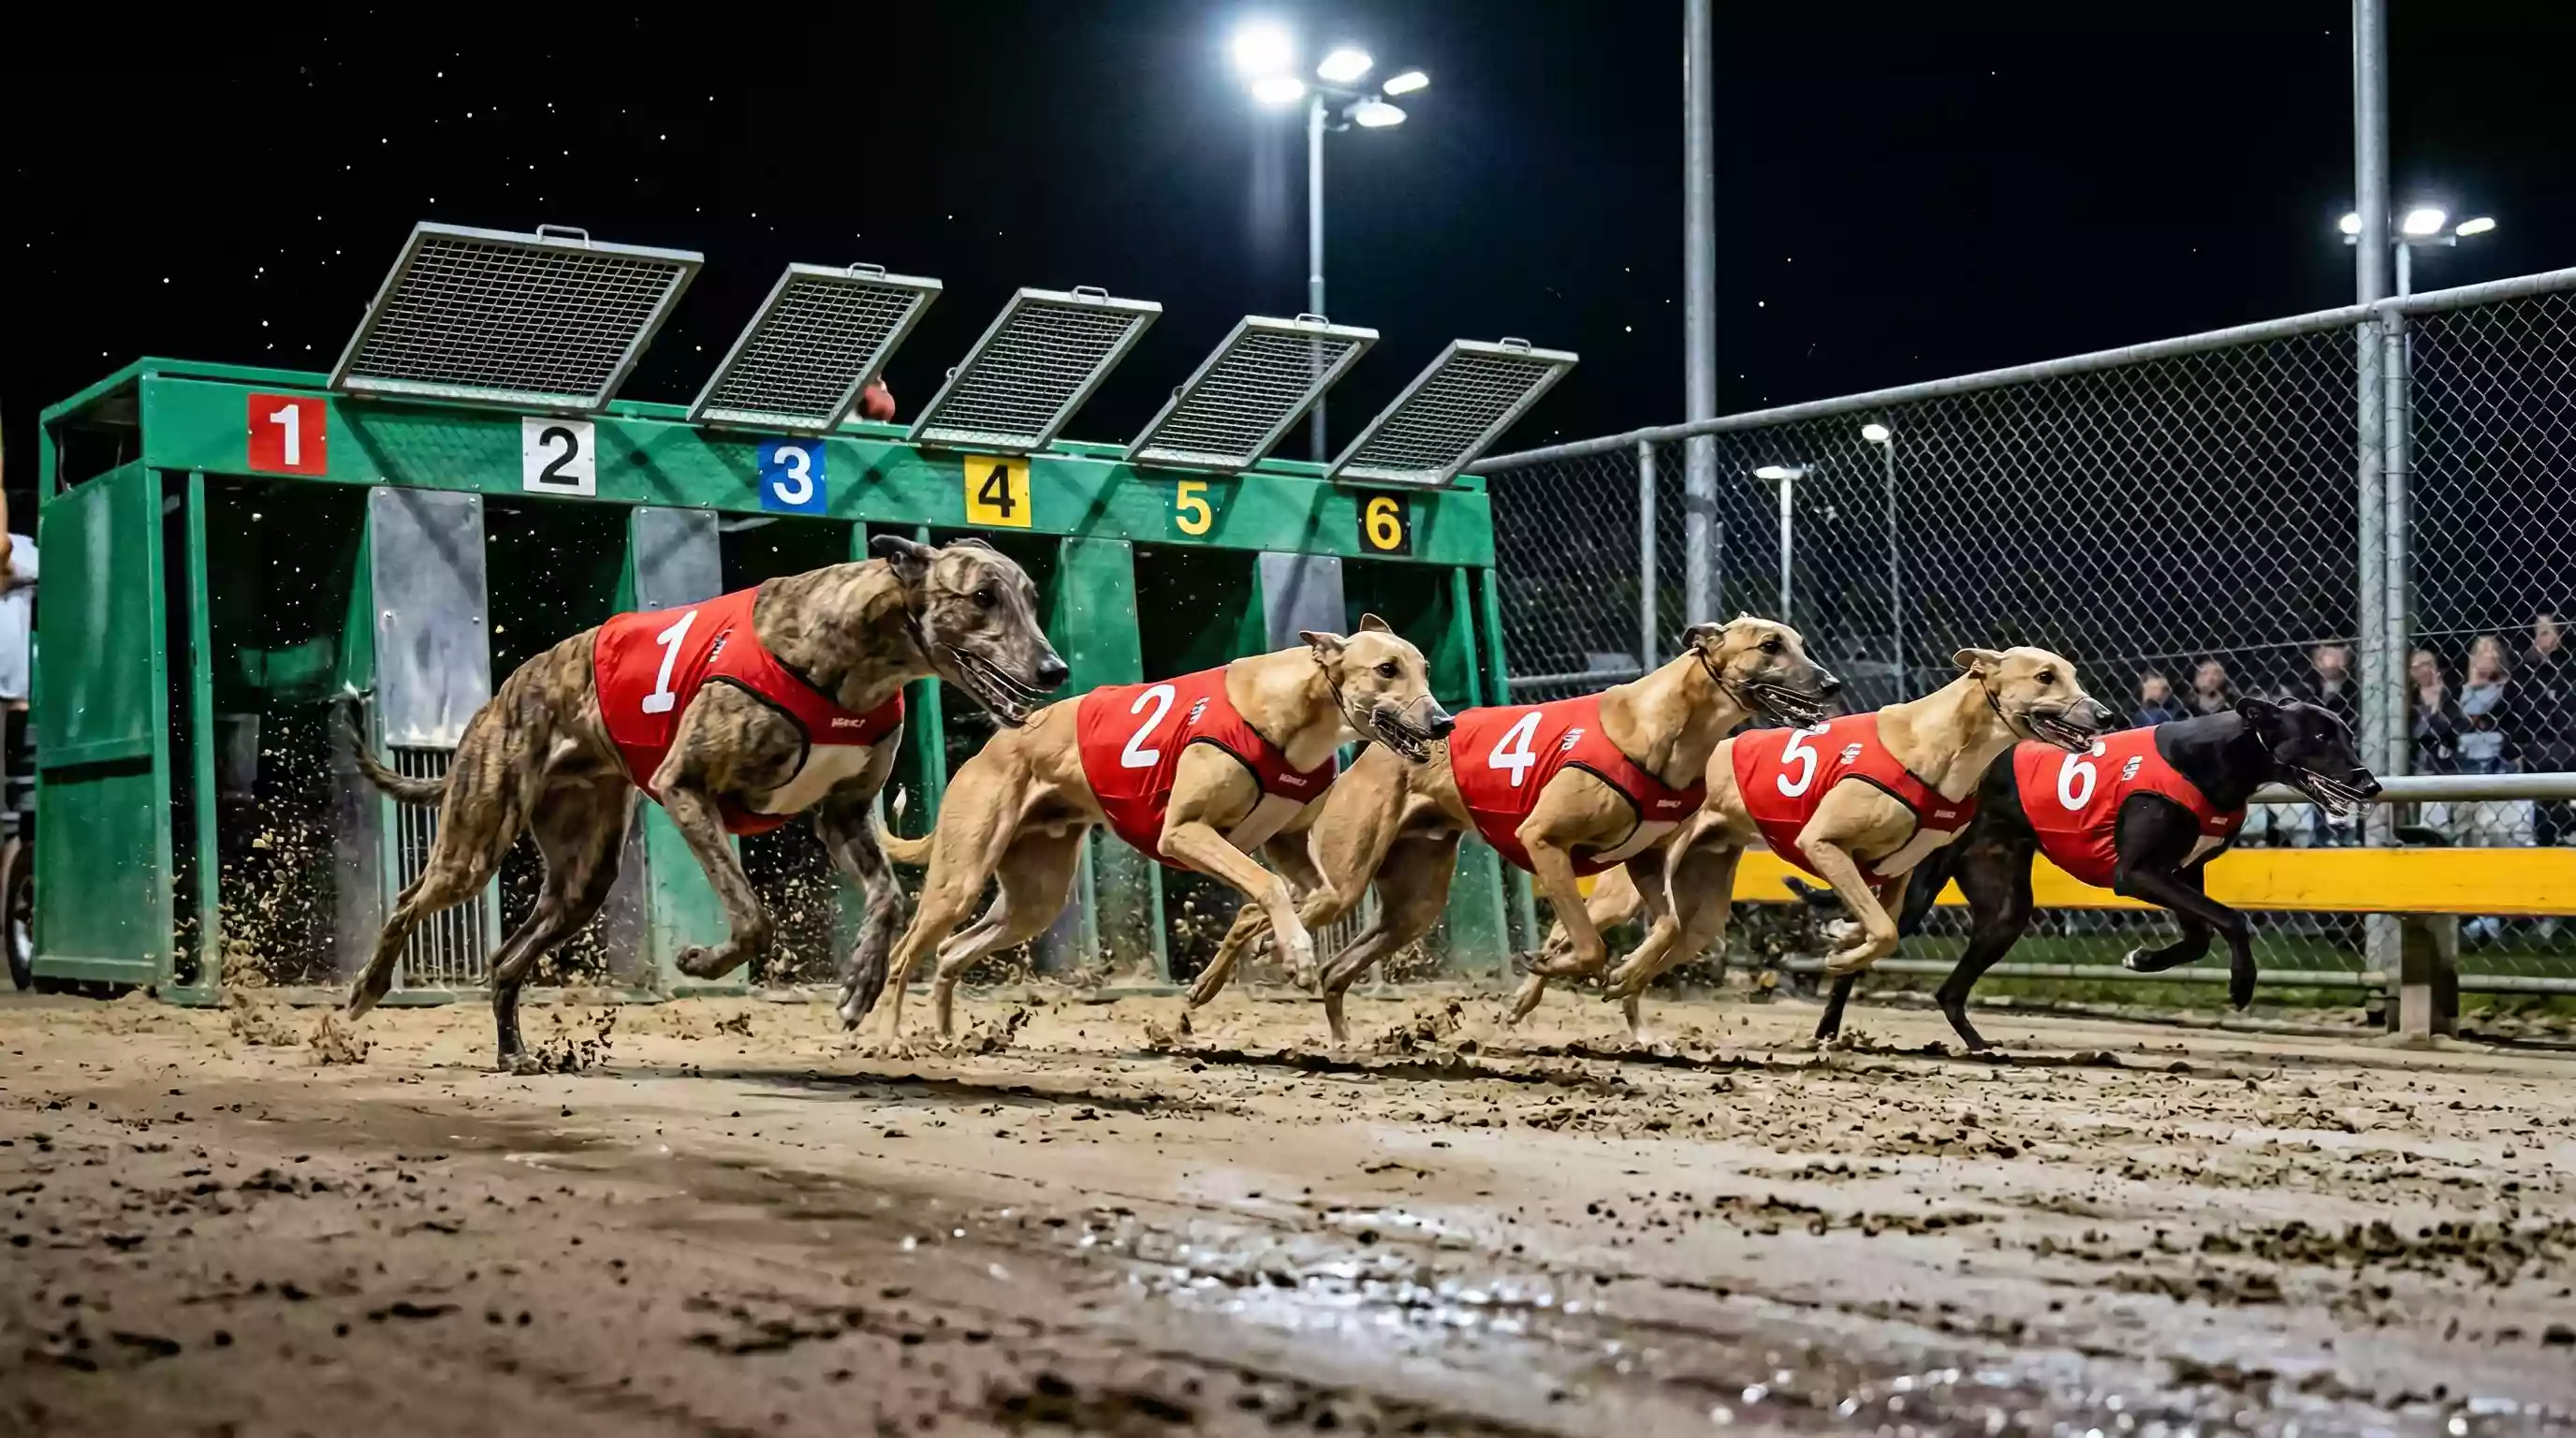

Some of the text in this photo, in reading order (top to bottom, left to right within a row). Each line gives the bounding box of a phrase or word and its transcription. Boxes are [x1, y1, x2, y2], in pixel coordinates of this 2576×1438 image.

[270, 404, 300, 465] 1
[538, 426, 579, 486] 2
[772, 446, 813, 506] 3
[978, 464, 1017, 518] 4
[1176, 480, 1212, 536] 5
[1366, 496, 1402, 550] 6
[642, 609, 698, 714] 1
[1121, 683, 1176, 768] 2
[1488, 712, 1543, 787] 4
[1777, 724, 1831, 798] 5
[2057, 741, 2106, 811] 6
